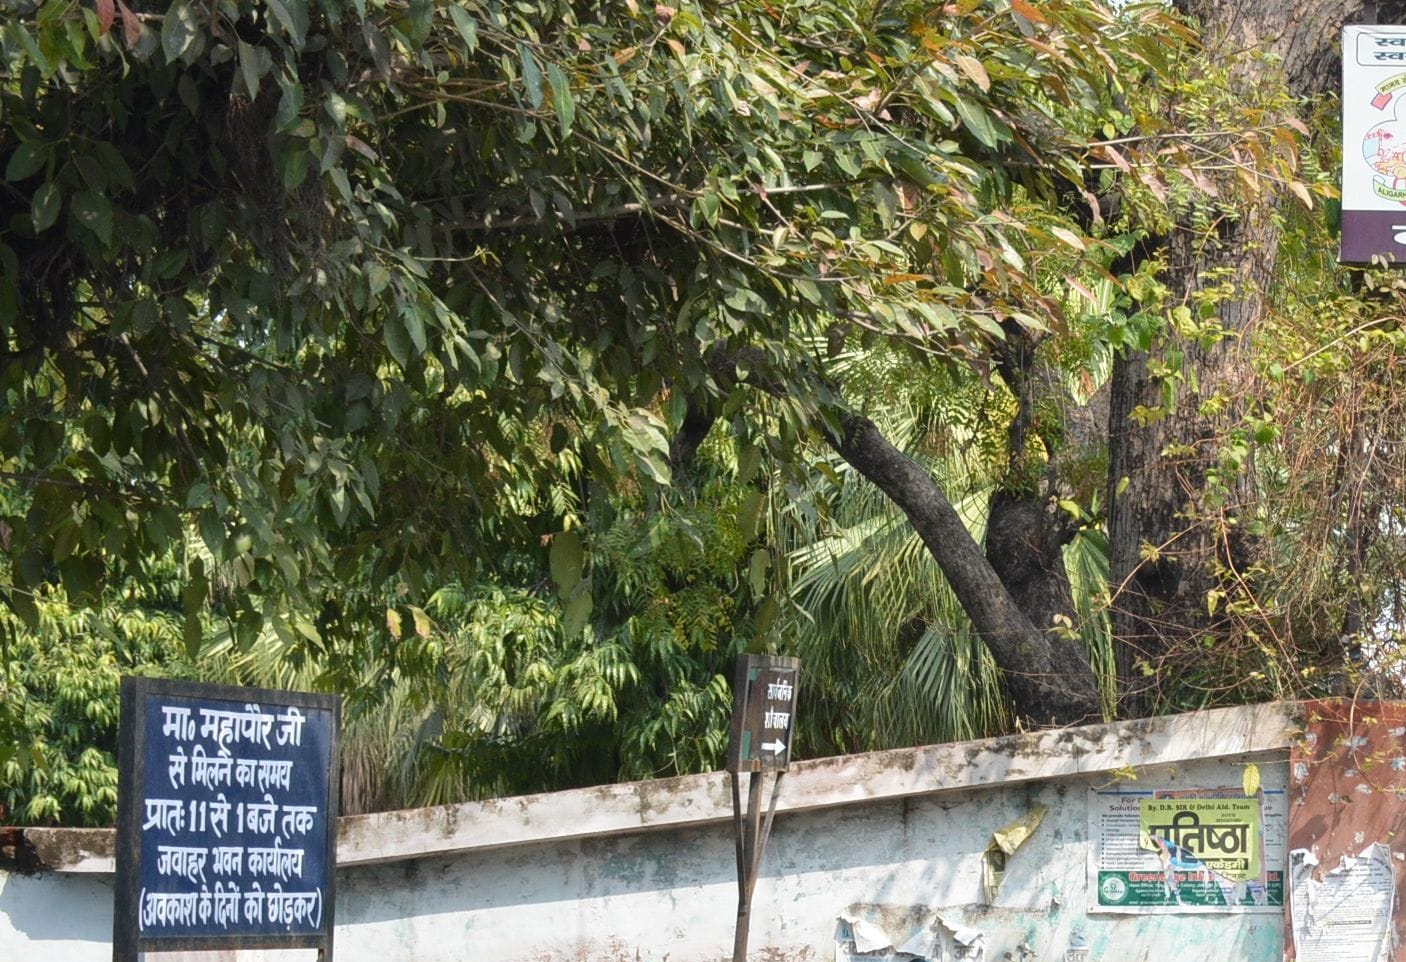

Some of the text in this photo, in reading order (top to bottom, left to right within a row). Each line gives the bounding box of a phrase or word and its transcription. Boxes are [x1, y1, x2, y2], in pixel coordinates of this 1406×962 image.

[200, 703, 275, 756] महापौर
[276, 706, 306, 747] जी
[169, 744, 293, 793] से मिलने का समय
[189, 800, 207, 832] 11
[209, 793, 230, 837] से
[236, 801, 245, 833] 1
[246, 794, 279, 834] बजे
[282, 806, 317, 838] तक
[157, 836, 304, 883] जवाहर भवन कार्यालय
[199, 884, 212, 926] के
[214, 881, 242, 929] दिनों
[244, 882, 264, 923] को
